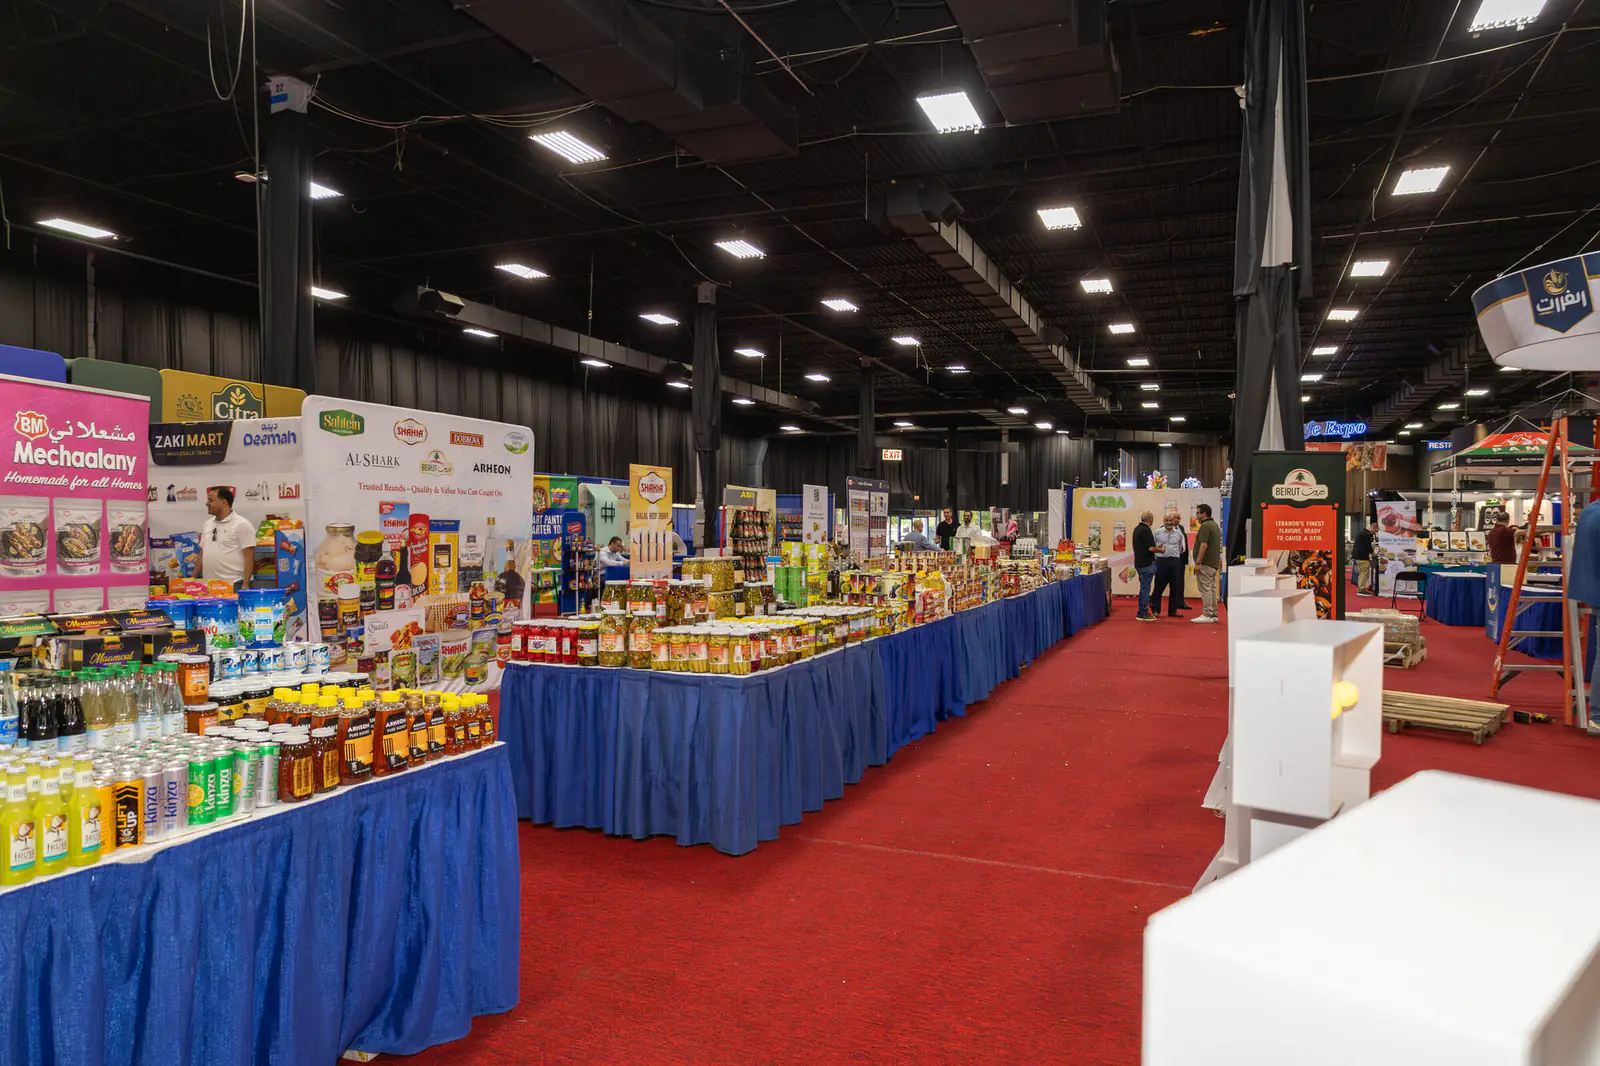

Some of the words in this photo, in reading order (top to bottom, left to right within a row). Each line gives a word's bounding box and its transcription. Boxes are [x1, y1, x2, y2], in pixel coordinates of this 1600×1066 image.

[21, 416, 43, 434] BM
[49, 420, 136, 443] مشعلاني
[397, 427, 424, 438] SHAHIA
[1323, 420, 1367, 438] Expo
[155, 435, 184, 448] ZAKI
[187, 433, 224, 447] MART
[243, 430, 297, 446] Deemah
[13, 440, 137, 476] Mechaalany
[883, 451, 901, 459] EXIT
[473, 463, 511, 475] ARHEON
[4, 471, 69, 486] Homemade
[69, 476, 89, 491] for
[91, 477, 108, 489] all
[111, 478, 143, 490] Homes
[641, 483, 664, 494] SHAHIA
[358, 482, 382, 491] Trusted
[384, 483, 405, 492] Brands
[411, 485, 432, 495] Quality
[434, 486, 439, 494] &
[440, 486, 456, 494] Value
[457, 487, 466, 495] You
[468, 488, 477, 496] Can
[479, 488, 493, 496] Count
[494, 489, 502, 497] On
[1275, 487, 1300, 496] BEIRUT
[1086, 495, 1127, 509] AZRA
[441, 643, 467, 655] SHAHIA
[205, 774, 216, 811] kinza
[217, 769, 230, 805] kinza
[144, 786, 159, 824] kinza
[164, 781, 179, 818] kinza
[117, 804, 128, 828] LIFT
[127, 811, 138, 827] UP
